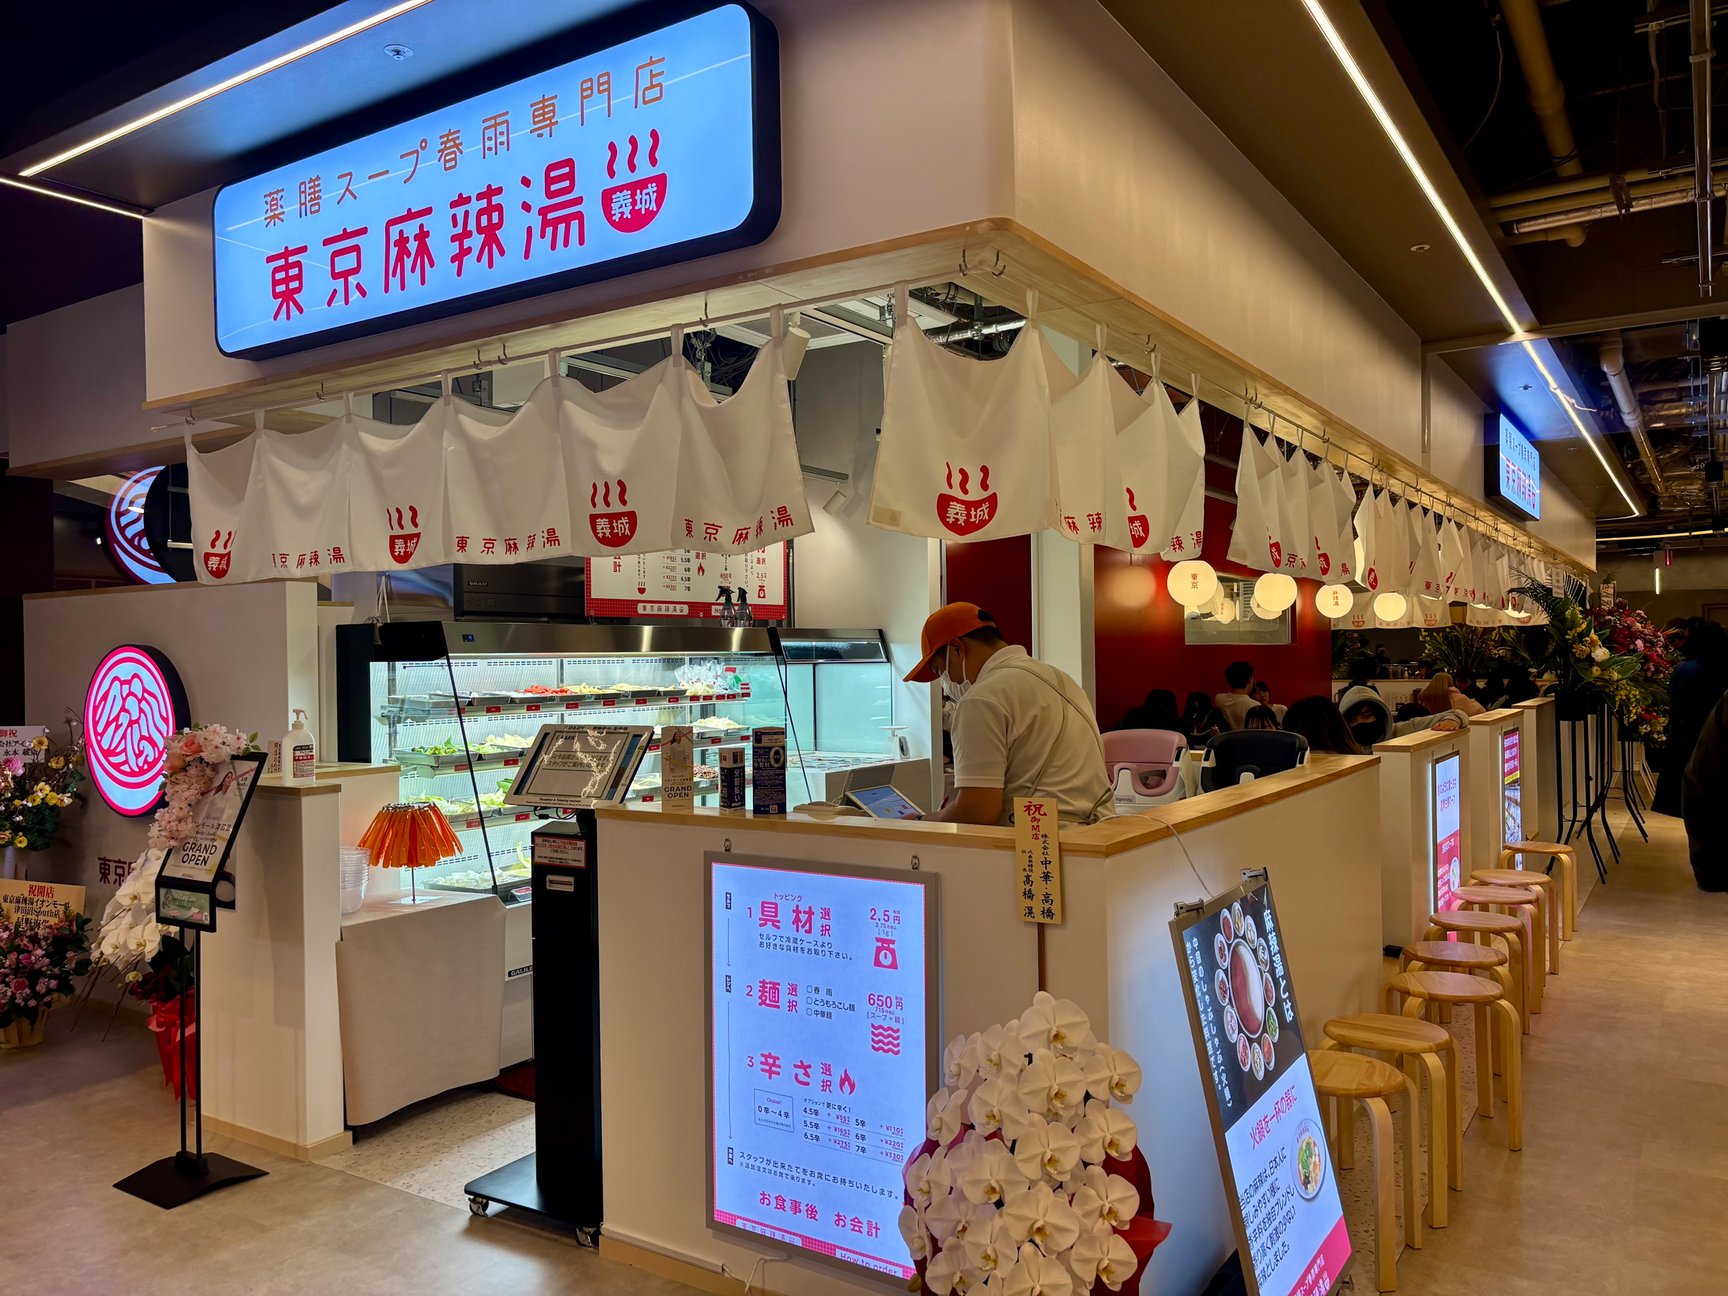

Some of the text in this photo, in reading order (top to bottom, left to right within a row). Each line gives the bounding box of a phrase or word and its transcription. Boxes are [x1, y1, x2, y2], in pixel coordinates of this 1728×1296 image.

[263, 55, 667, 229] 薬膳スープ春雨専門店
[610, 181, 657, 222] 義城
[265, 157, 585, 323] 東京麻辣湯
[945, 501, 990, 527] 義城
[595, 516, 629, 539] 義城
[683, 505, 794, 547] 東京麻辣湯
[393, 537, 418, 557] 義城
[455, 527, 561, 555] 東京麻辣湯
[664, 785, 692, 793] GRAND
[1023, 801, 1048, 817] 祝
[182, 841, 218, 855] GRAND
[181, 852, 210, 867] OPEN
[28, 883, 56, 899] 祝開店
[773, 892, 803, 903] トッピング
[747, 900, 832, 937] 1 具材 選択
[758, 932, 833, 949] セルフで冷蔵ケースより
[758, 941, 853, 961] お好きな具材をお取り下さい。
[745, 979, 798, 1014] 2 麺 選択
[813, 997, 856, 1013] とうもろこし麺
[747, 1051, 832, 1094] 3 辛さ 選択
[802, 1106, 820, 1118] 4.5辛
[1249, 1084, 1298, 1151] 火鍋を一杯の器に
[802, 1119, 820, 1131] 5.5辛
[855, 1117, 867, 1128] 5辛
[803, 1132, 821, 1143] 6.5辛
[854, 1132, 867, 1142] 6辛
[855, 1144, 867, 1155] 7辛
[739, 1150, 899, 1200] スタッフが出来たてをお席にお持ちいたします。
[759, 1189, 881, 1239] お食事後 お会計
